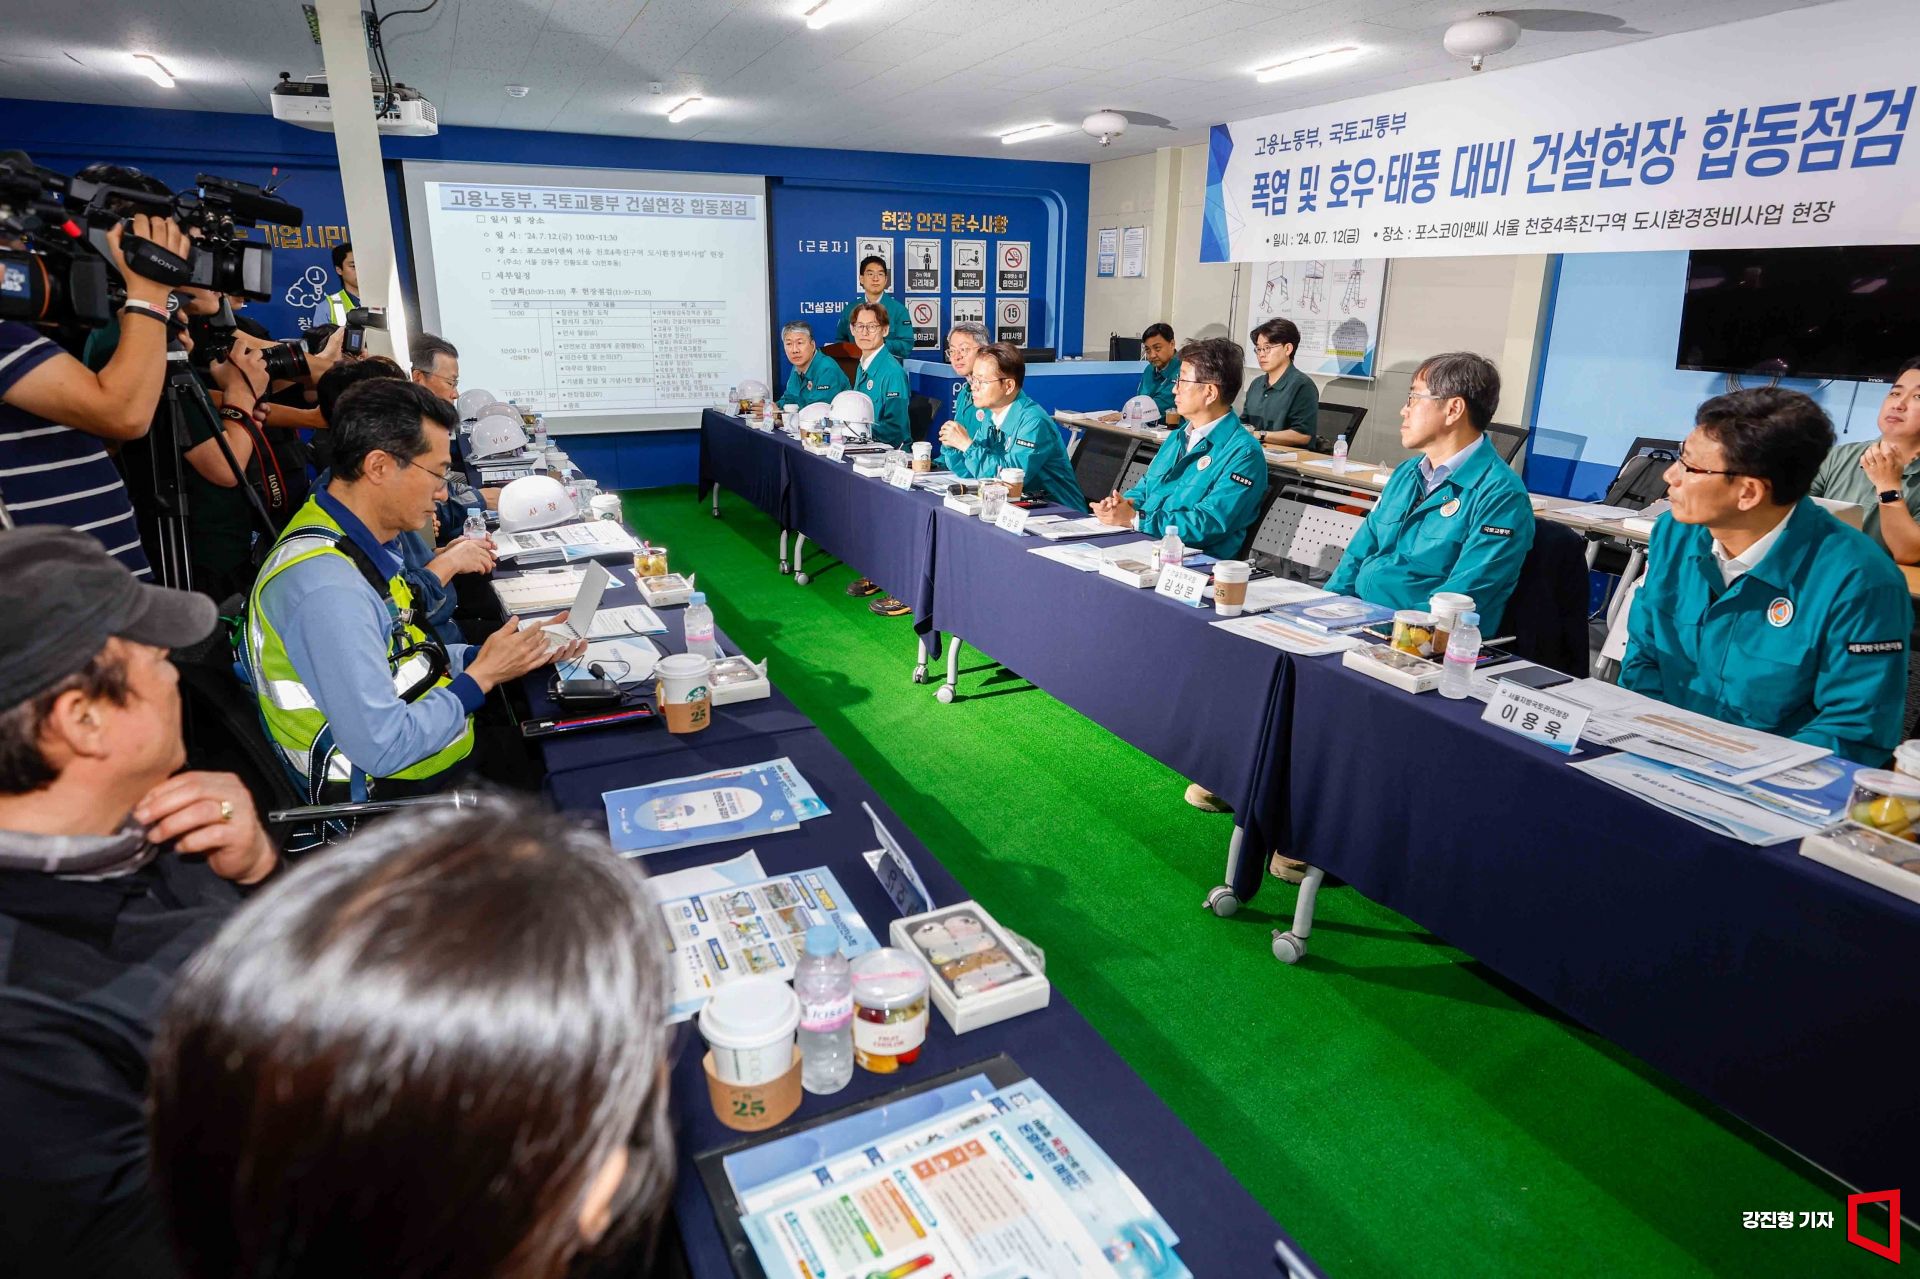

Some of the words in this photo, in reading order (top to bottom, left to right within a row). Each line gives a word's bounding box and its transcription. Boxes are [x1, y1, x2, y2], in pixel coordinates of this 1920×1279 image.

[1253, 125, 1323, 157] 고용노동부,
[1329, 112, 1408, 146] 국토교통부
[1250, 168, 1291, 217] 폭염
[1297, 162, 1321, 215] 및
[1326, 146, 1442, 210] 호우·태풍
[1450, 137, 1513, 200] 대비
[1525, 115, 1686, 196] 건설현장
[1697, 84, 1919, 181] 합동점검
[450, 190, 537, 208] 고용노동부,
[543, 193, 621, 211] 국토교통부
[625, 196, 685, 214] 건설현장
[690, 199, 748, 217] 합동점검
[490, 216, 508, 224] 일시
[514, 216, 522, 224] 및
[527, 217, 545, 225] 장소
[881, 210, 912, 231] 현장
[916, 212, 947, 232] 안전
[951, 213, 1008, 234] 준수사항
[1382, 227, 1404, 242] 장소
[1415, 220, 1489, 240] 포스코이앤씨
[1493, 219, 1520, 237] 서울
[1524, 212, 1627, 235] 천호4촉진구역
[1632, 204, 1784, 230] 도시환경정비사업
[1791, 200, 1836, 224] 현장
[1273, 233, 1288, 247] 일시
[1314, 231, 1329, 244] 07.
[1333, 228, 1360, 244] 12(금)
[150, 254, 180, 272] SONY
[1007, 307, 1018, 318] 15
[265, 474, 283, 508] Canon
[1164, 578, 1194, 599] 김상문
[690, 710, 706, 722] 25
[1501, 704, 1562, 740] 이용욱
[732, 1100, 766, 1117] 25
